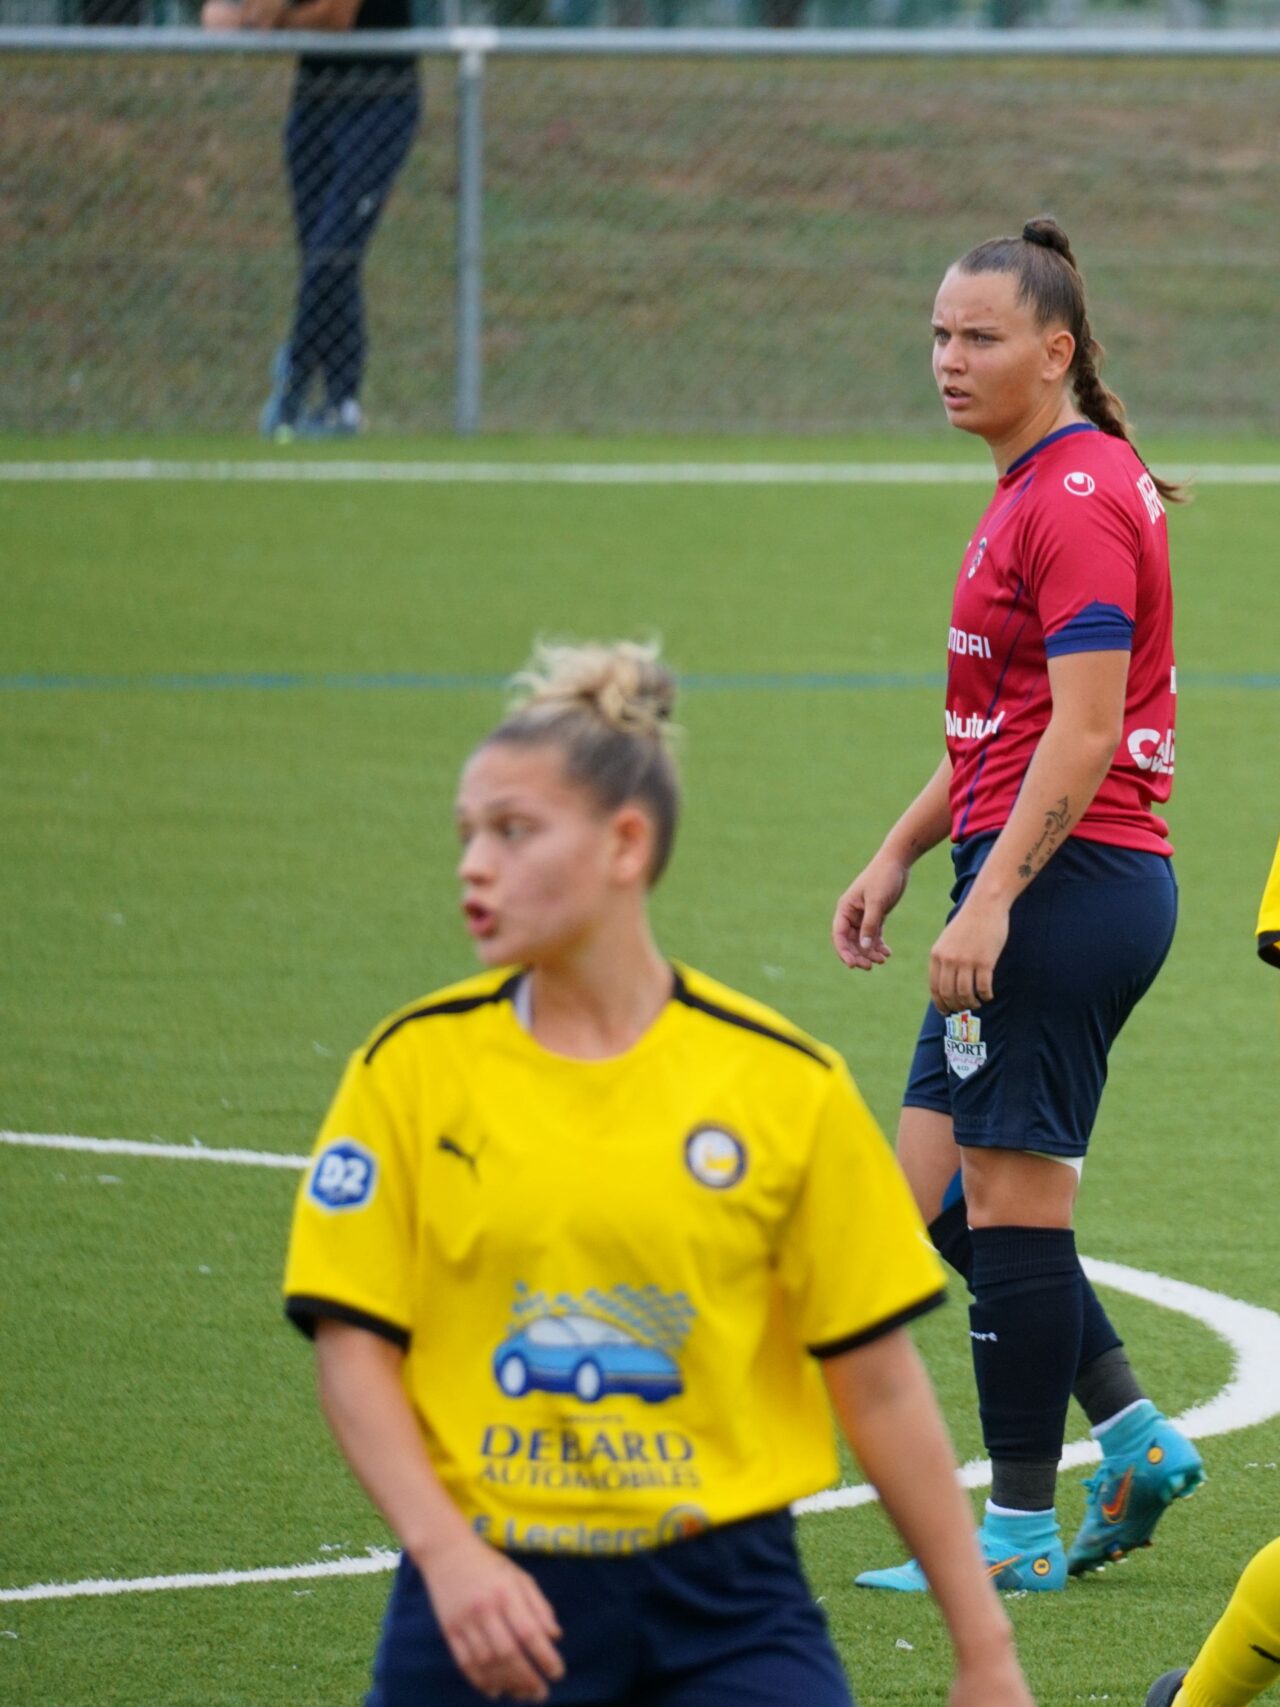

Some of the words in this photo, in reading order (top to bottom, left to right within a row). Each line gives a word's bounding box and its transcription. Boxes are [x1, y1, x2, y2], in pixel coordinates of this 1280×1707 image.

[946, 1040, 984, 1056] SPORT
[319, 1154, 366, 1193] D2
[480, 1423, 694, 1463] DEBARD
